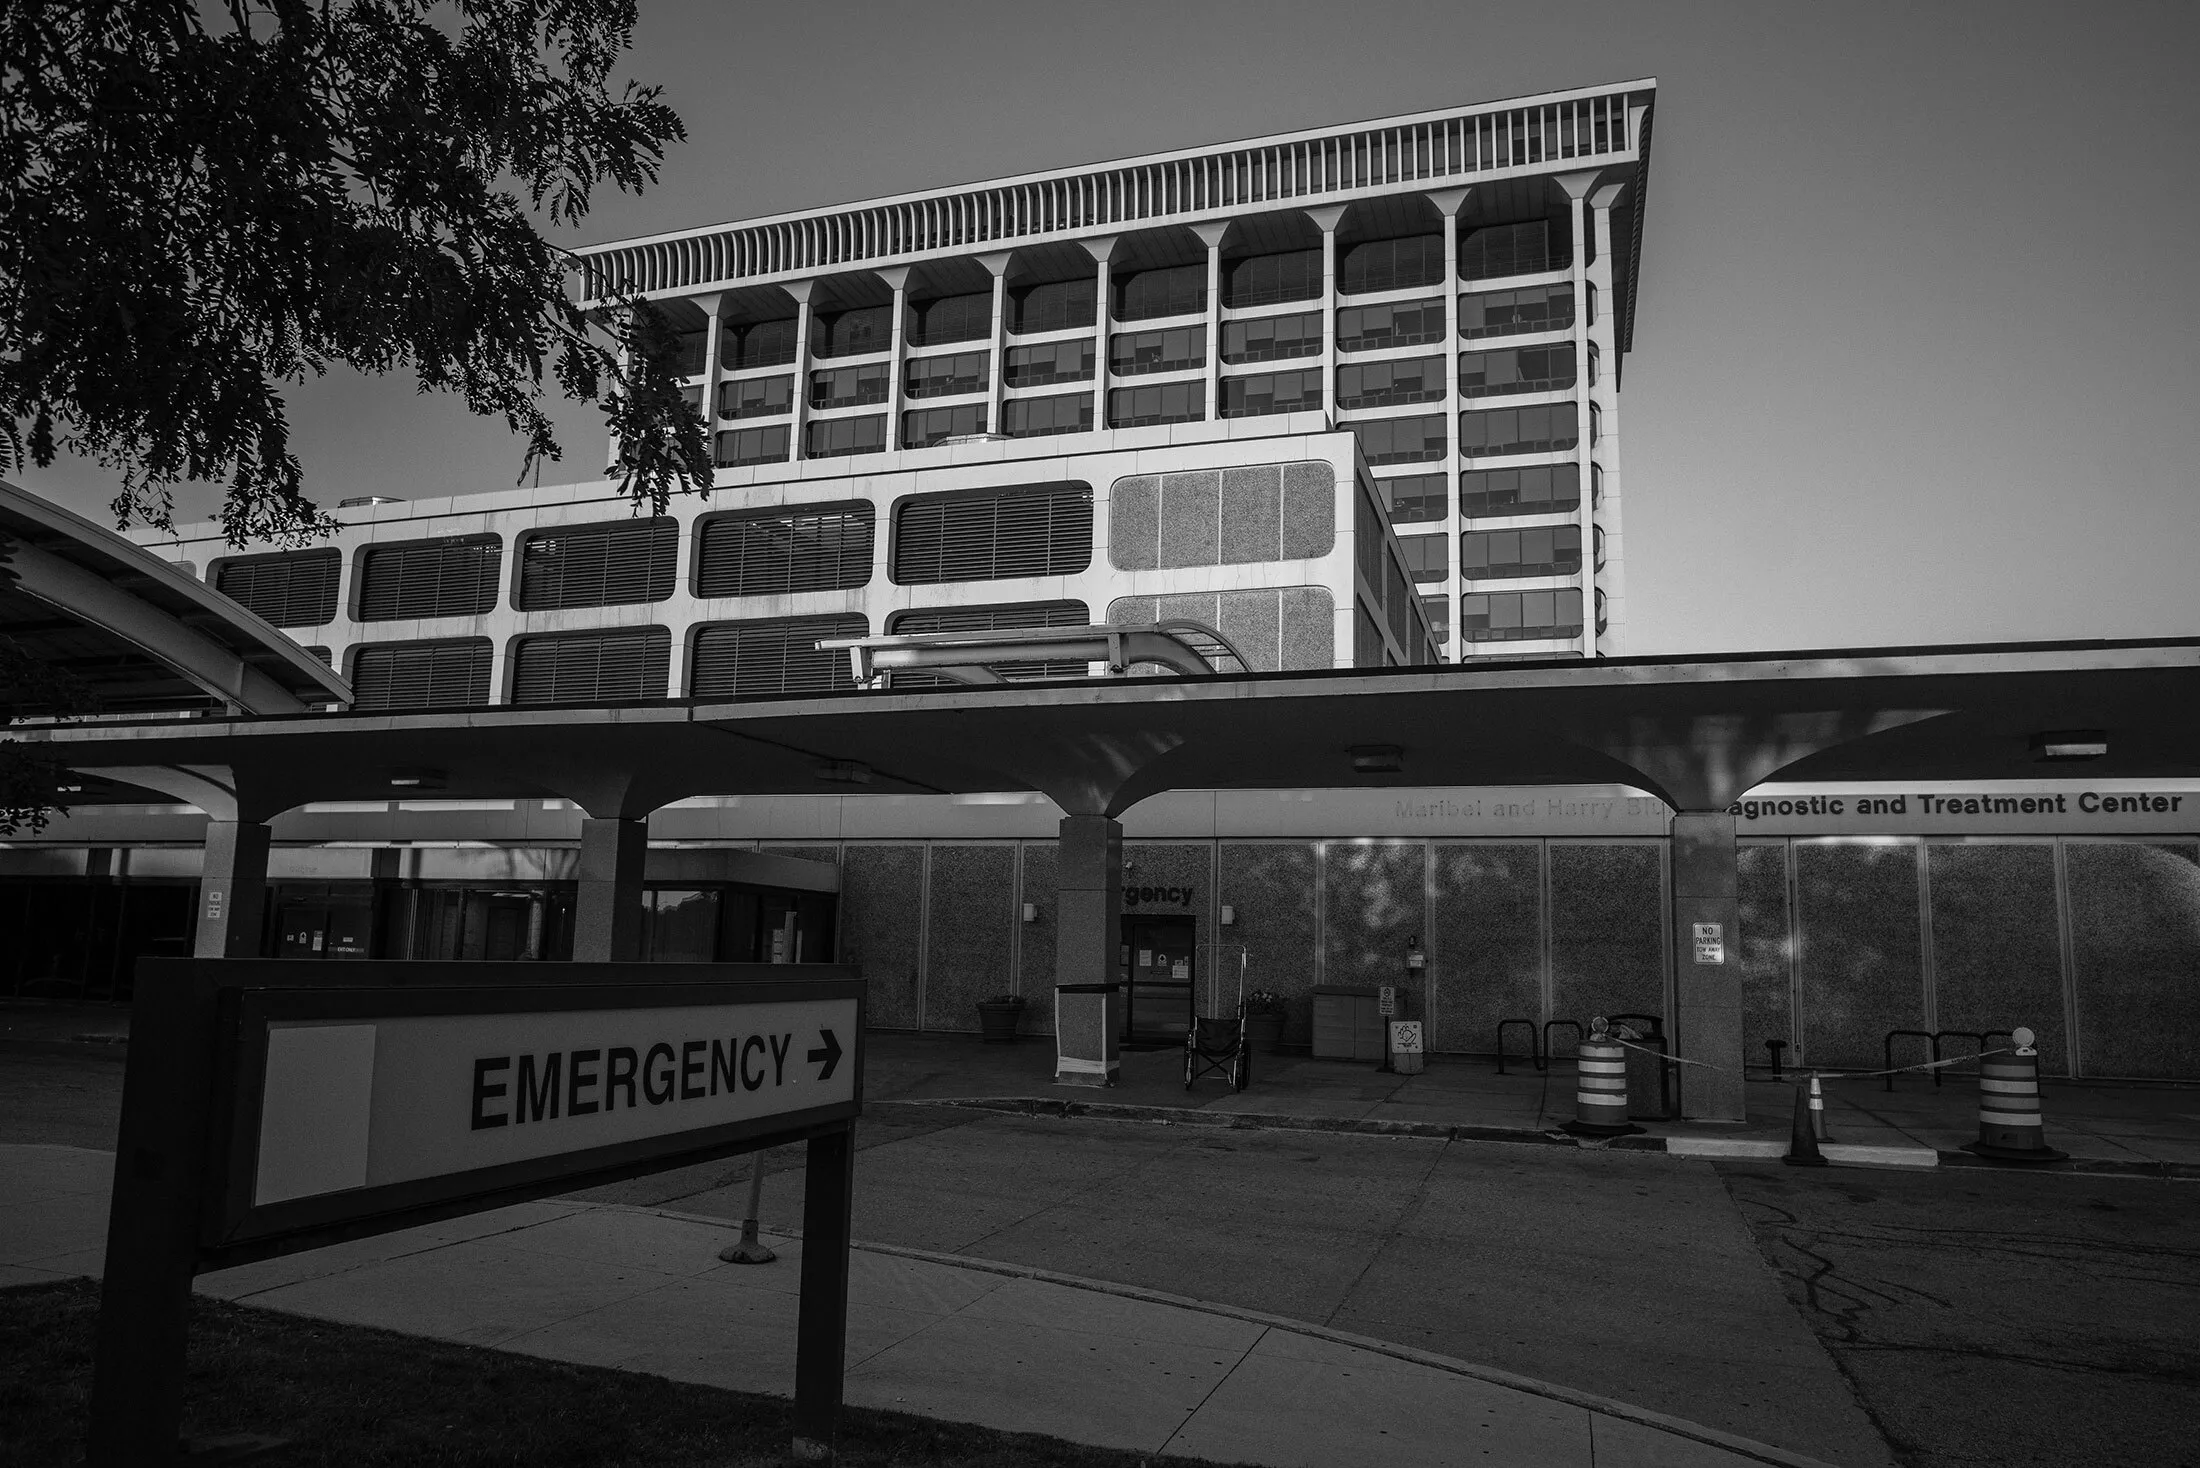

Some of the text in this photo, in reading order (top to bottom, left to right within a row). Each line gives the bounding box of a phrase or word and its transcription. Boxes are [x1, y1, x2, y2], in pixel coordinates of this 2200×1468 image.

[1493, 799, 1535, 817] and
[1728, 796, 1844, 820] agnostic
[1856, 795, 1907, 815] and
[1917, 793, 2066, 815] Treatment
[2078, 791, 2183, 814] Center
[1121, 887, 1193, 906] gency
[1695, 936, 1721, 945] PARKING
[1702, 927, 1713, 935] NO
[471, 1033, 792, 1131] EMERGENCY
